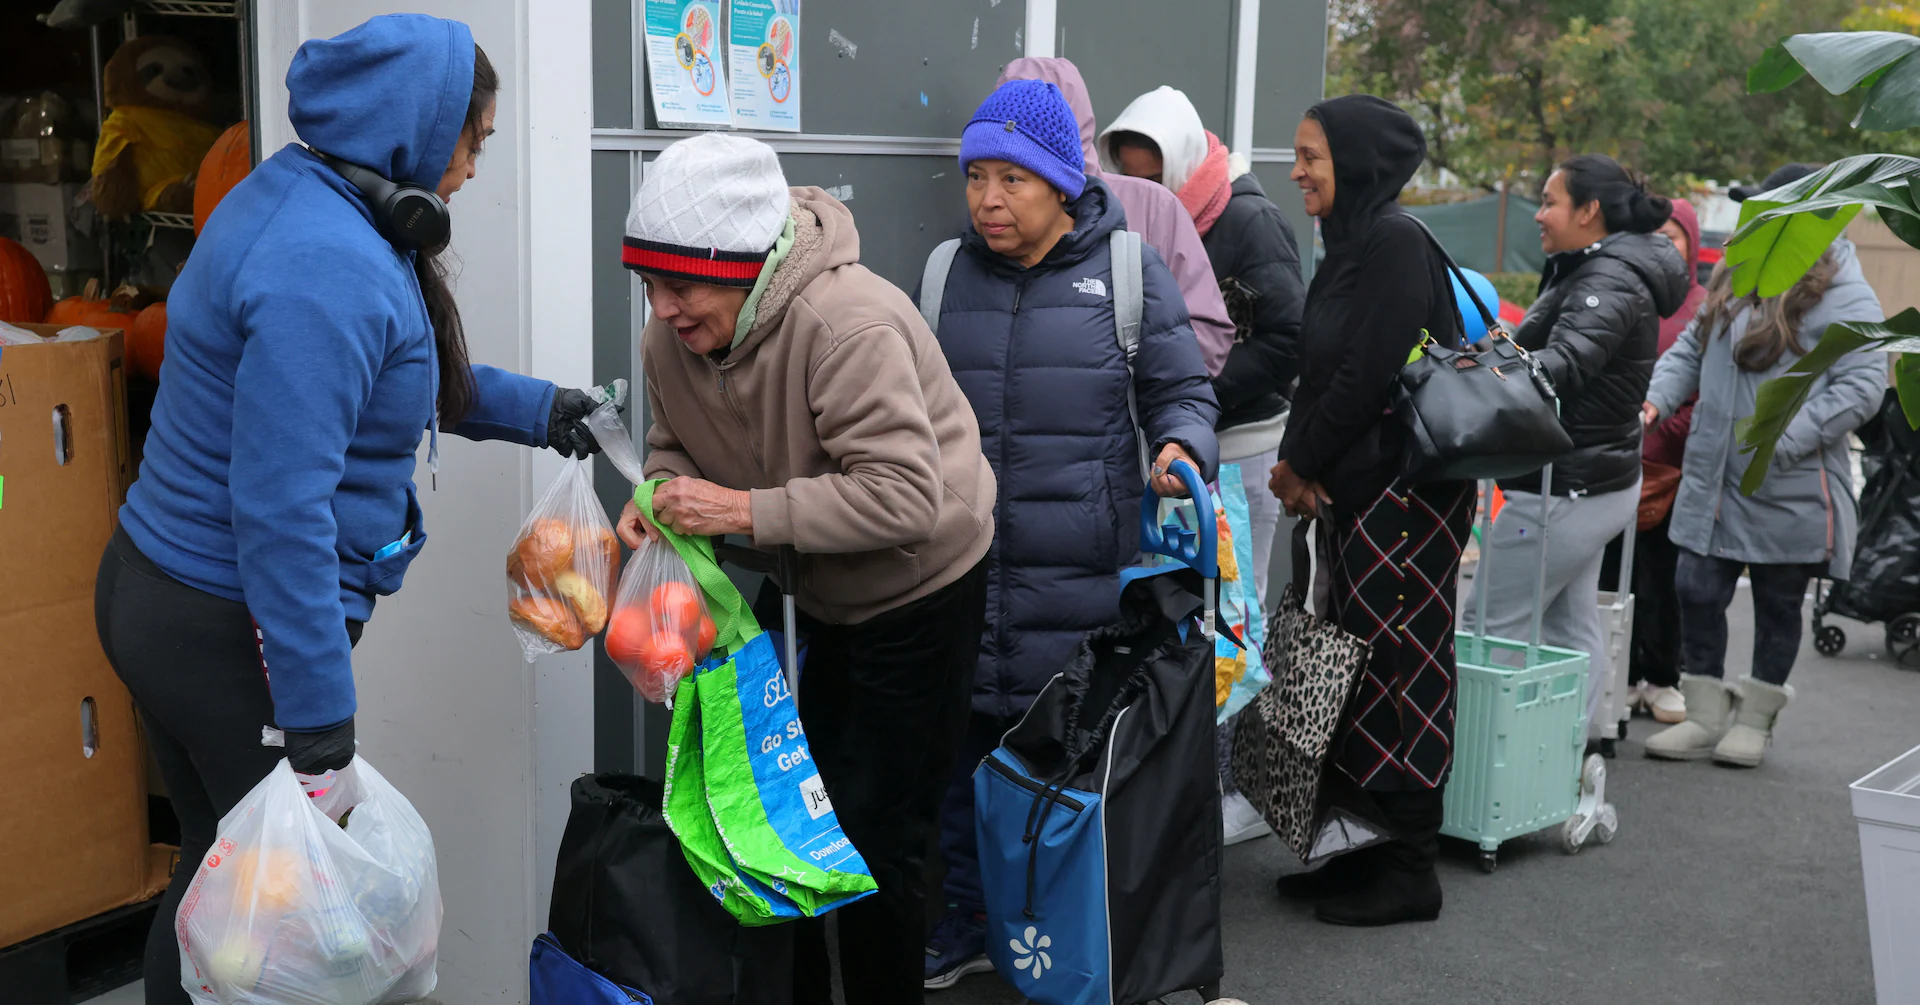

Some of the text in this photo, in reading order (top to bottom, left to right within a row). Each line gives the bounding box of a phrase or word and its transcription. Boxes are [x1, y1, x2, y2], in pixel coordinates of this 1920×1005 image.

[406, 207, 424, 228] GUESS
[761, 733, 783, 754] Go
[777, 745, 810, 772] Get
